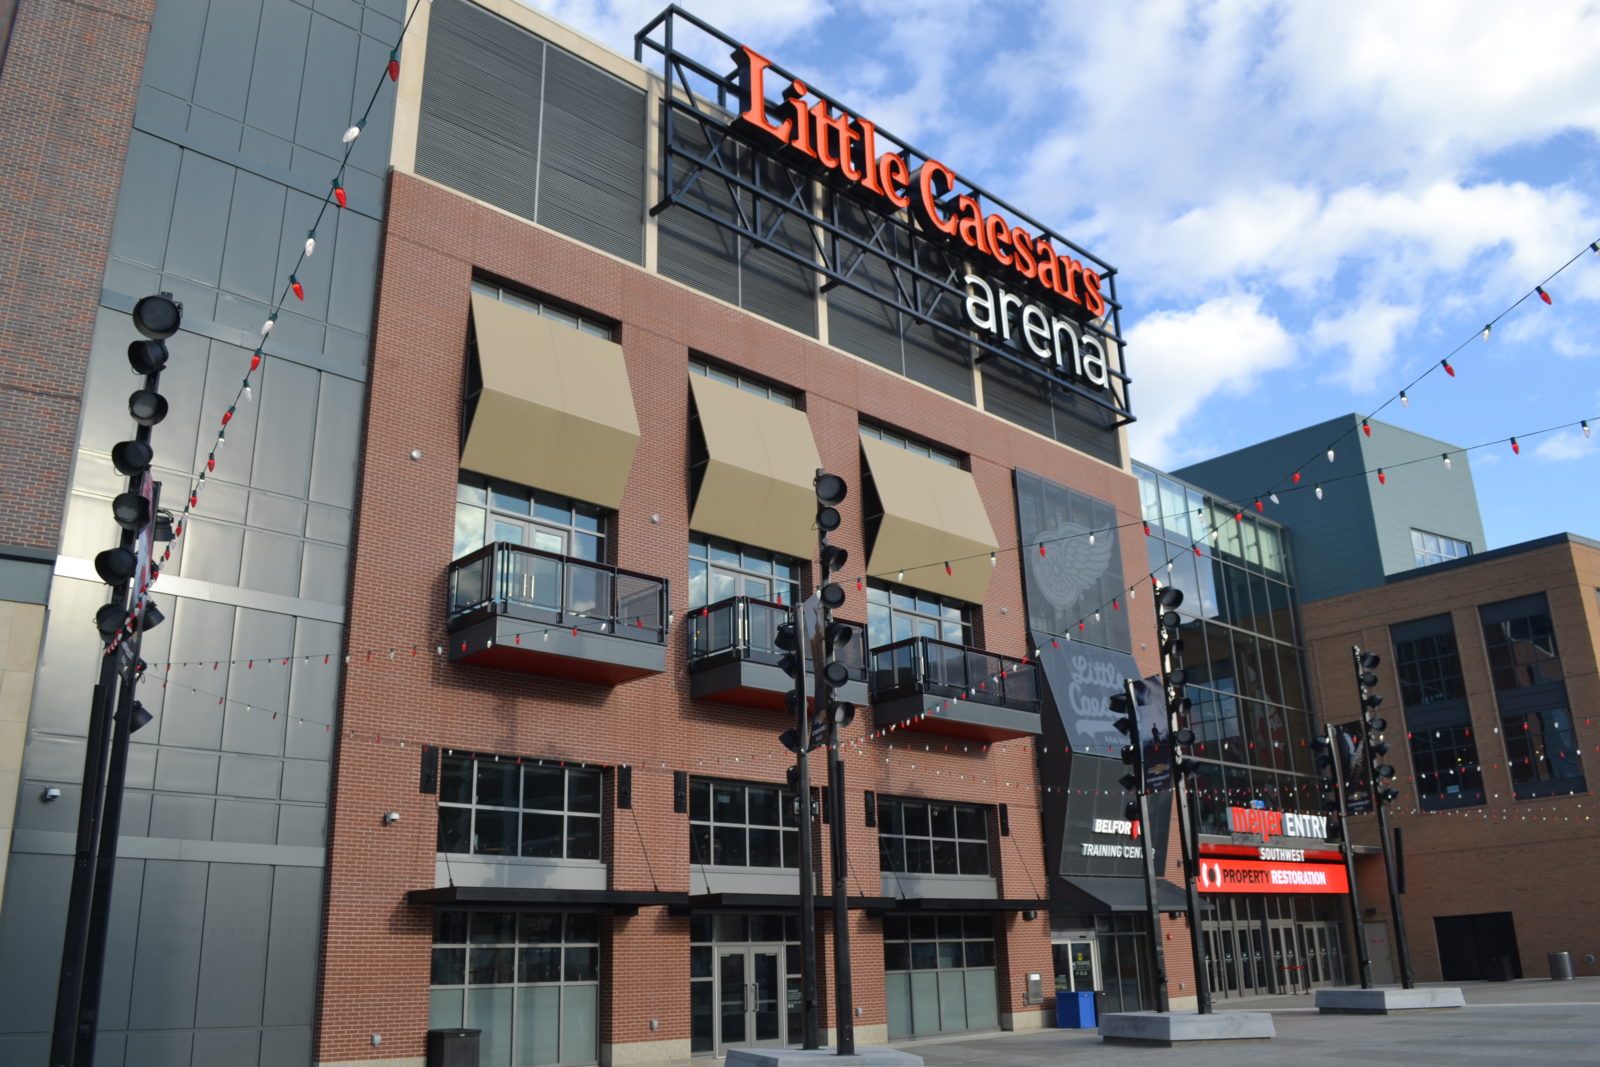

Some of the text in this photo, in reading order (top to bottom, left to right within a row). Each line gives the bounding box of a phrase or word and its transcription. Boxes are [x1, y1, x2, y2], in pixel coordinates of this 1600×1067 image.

[741, 44, 1105, 317] Little Caesars
[964, 273, 1109, 390] arena
[1094, 818, 1132, 836] BELFOR
[1230, 806, 1328, 842] meijer ENTRY
[1081, 843, 1123, 858] TRAINING
[1259, 847, 1305, 862] SOUTHWEST
[1223, 868, 1327, 885] PROPERTY RESTORATION
